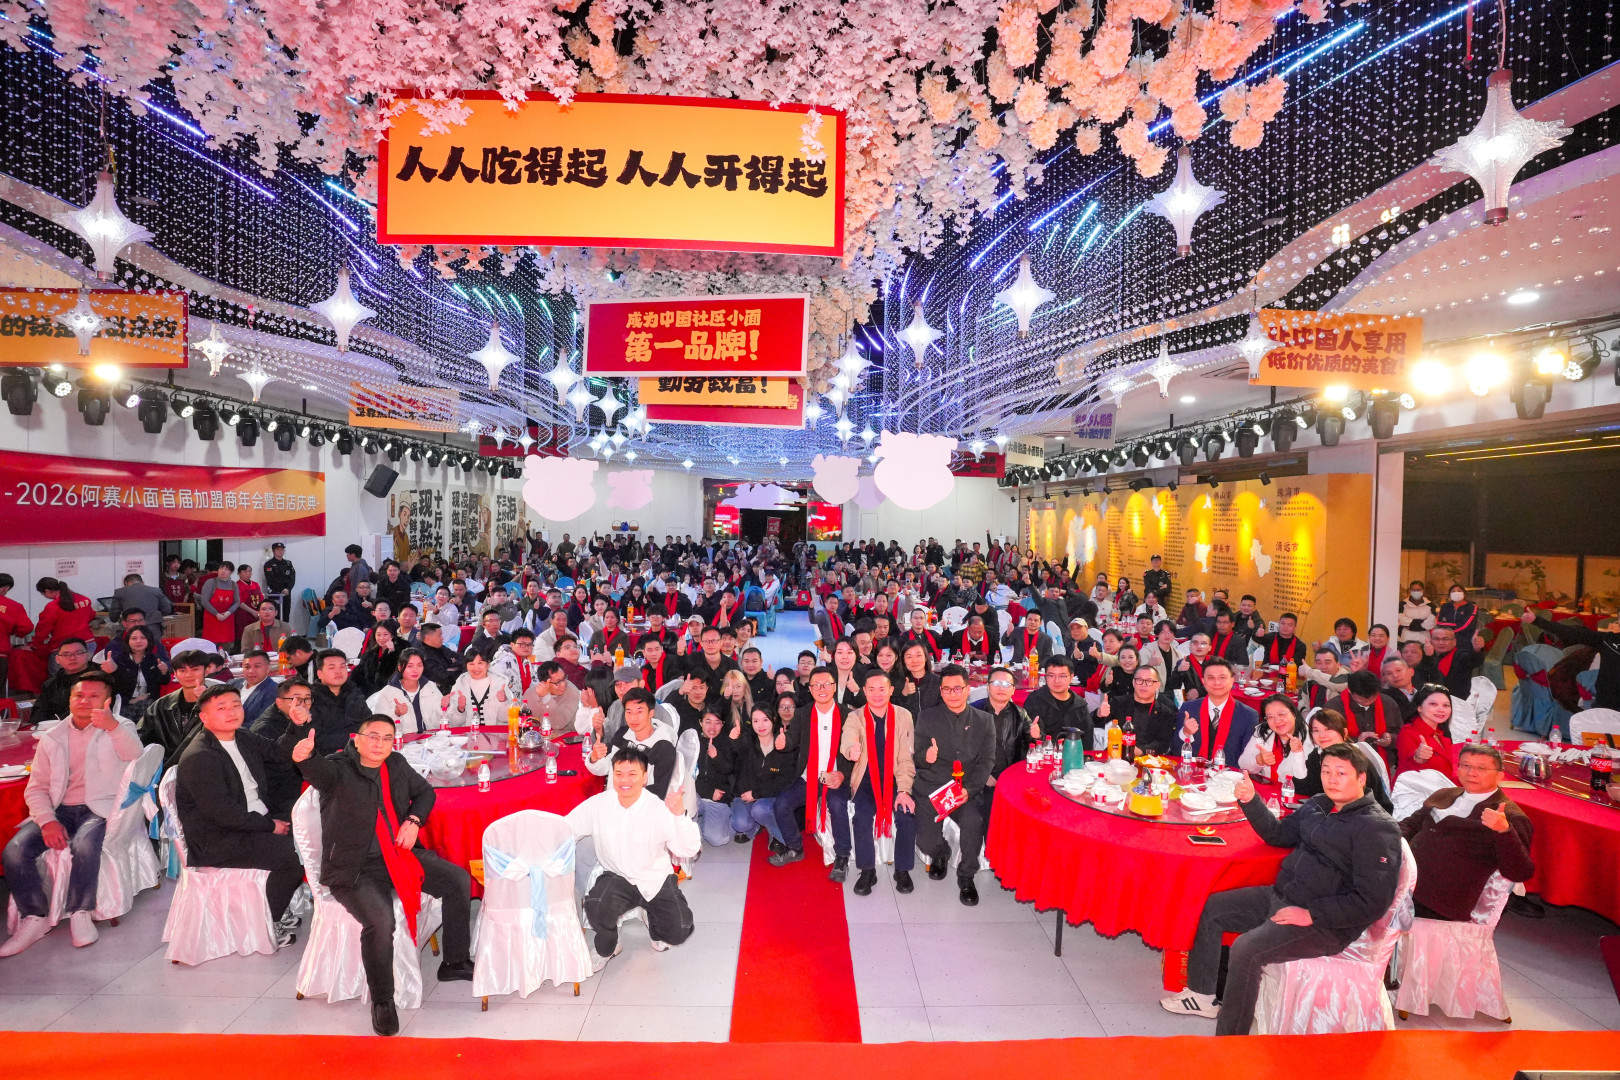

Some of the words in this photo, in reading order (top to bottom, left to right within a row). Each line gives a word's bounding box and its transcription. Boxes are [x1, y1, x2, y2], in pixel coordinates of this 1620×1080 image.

[396, 145, 608, 188] 人人吃得起
[616, 150, 828, 198] 人人开得起
[626, 308, 762, 329] 成为中国社区小面
[625, 329, 760, 362] 第一品牌!
[1267, 326, 1408, 354] 让中国人享用
[1266, 351, 1406, 375] 低价优质的美食!
